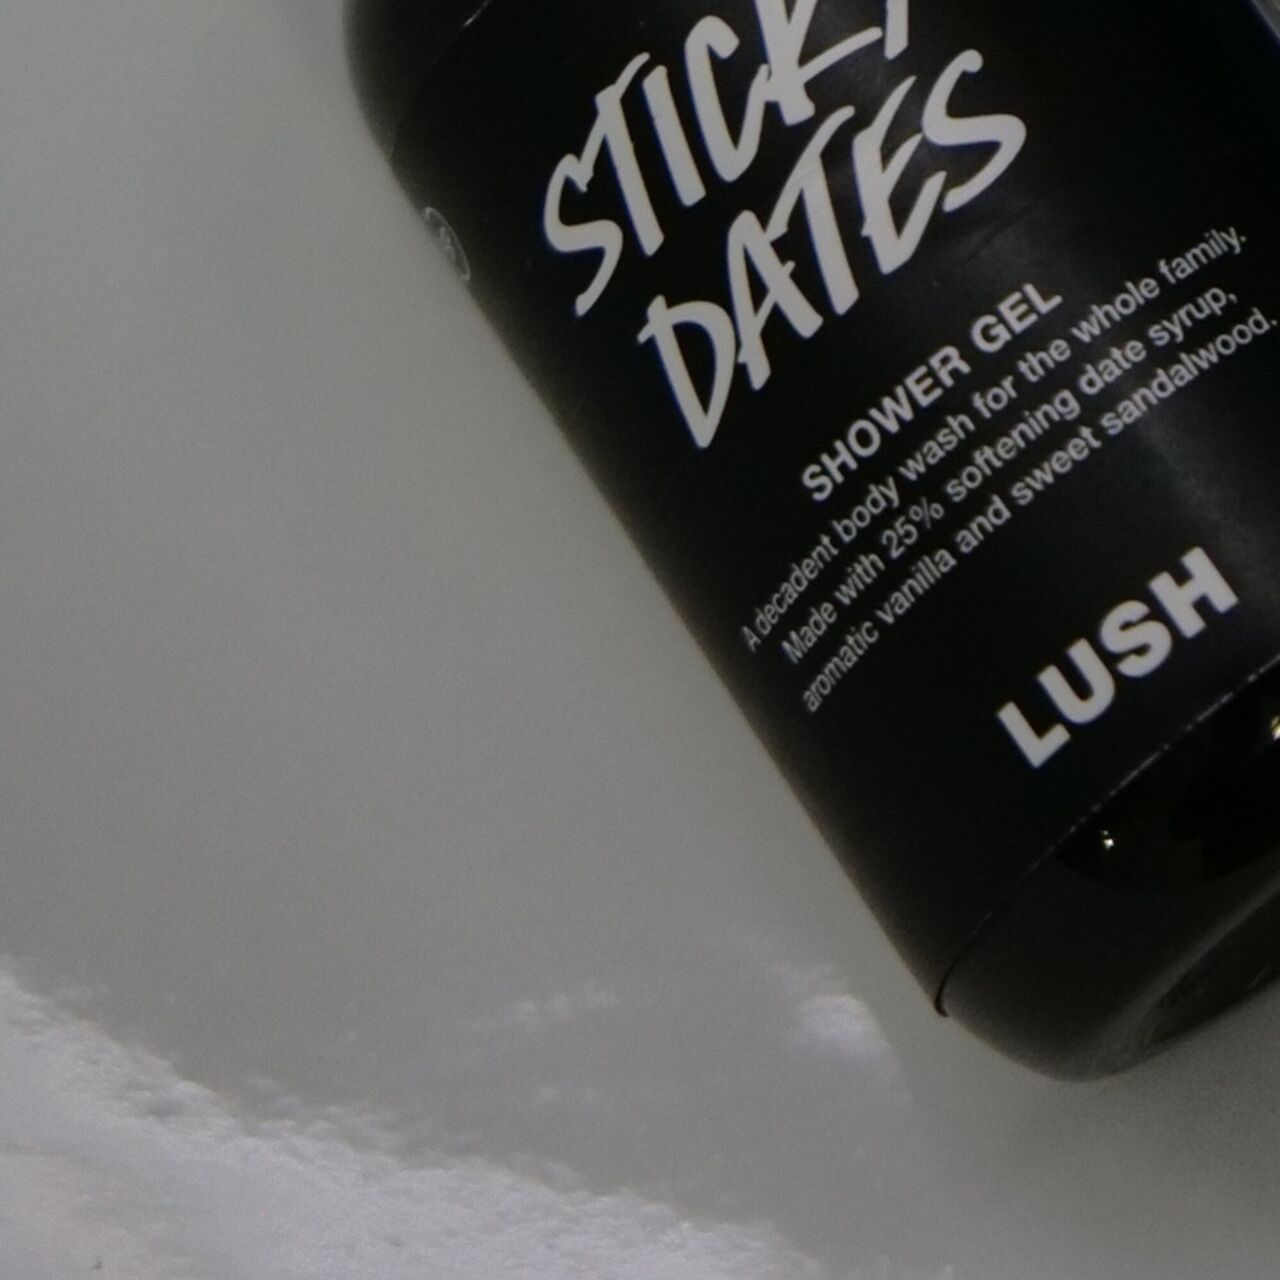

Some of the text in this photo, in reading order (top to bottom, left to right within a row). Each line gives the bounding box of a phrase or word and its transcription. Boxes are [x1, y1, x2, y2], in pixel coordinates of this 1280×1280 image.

[637, 48, 1027, 449] DATES
[741, 226, 1247, 652] A decadent body wash for the whole family.
[801, 283, 1063, 502] SHOWER GEL
[781, 287, 1238, 664] Made with 25% softening date syrup,
[802, 307, 1277, 713] aromatic vanilla and sweet sandalwood.
[998, 546, 1238, 768] LUSH
